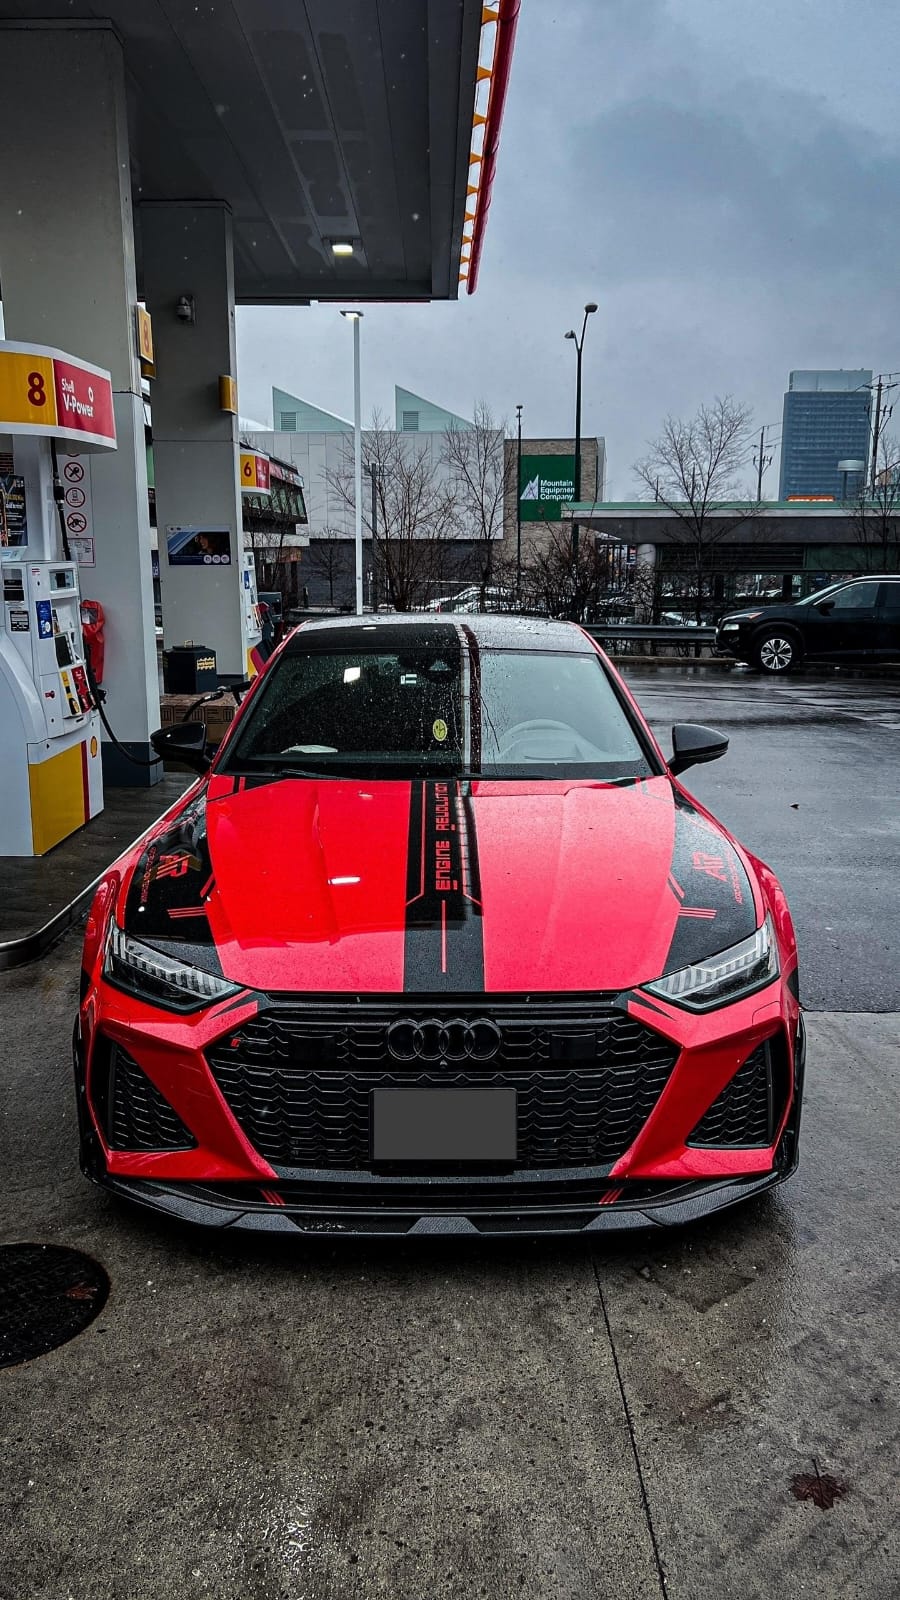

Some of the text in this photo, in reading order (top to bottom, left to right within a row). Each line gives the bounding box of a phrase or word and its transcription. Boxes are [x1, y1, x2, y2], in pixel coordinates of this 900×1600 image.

[28, 372, 46, 407] 8
[62, 377, 75, 394] Shell
[62, 393, 94, 418] V-Power
[243, 461, 252, 477] 6
[540, 486, 575, 494] Equipmen
[540, 493, 574, 501] Company
[435, 840, 451, 890] ENGINE
